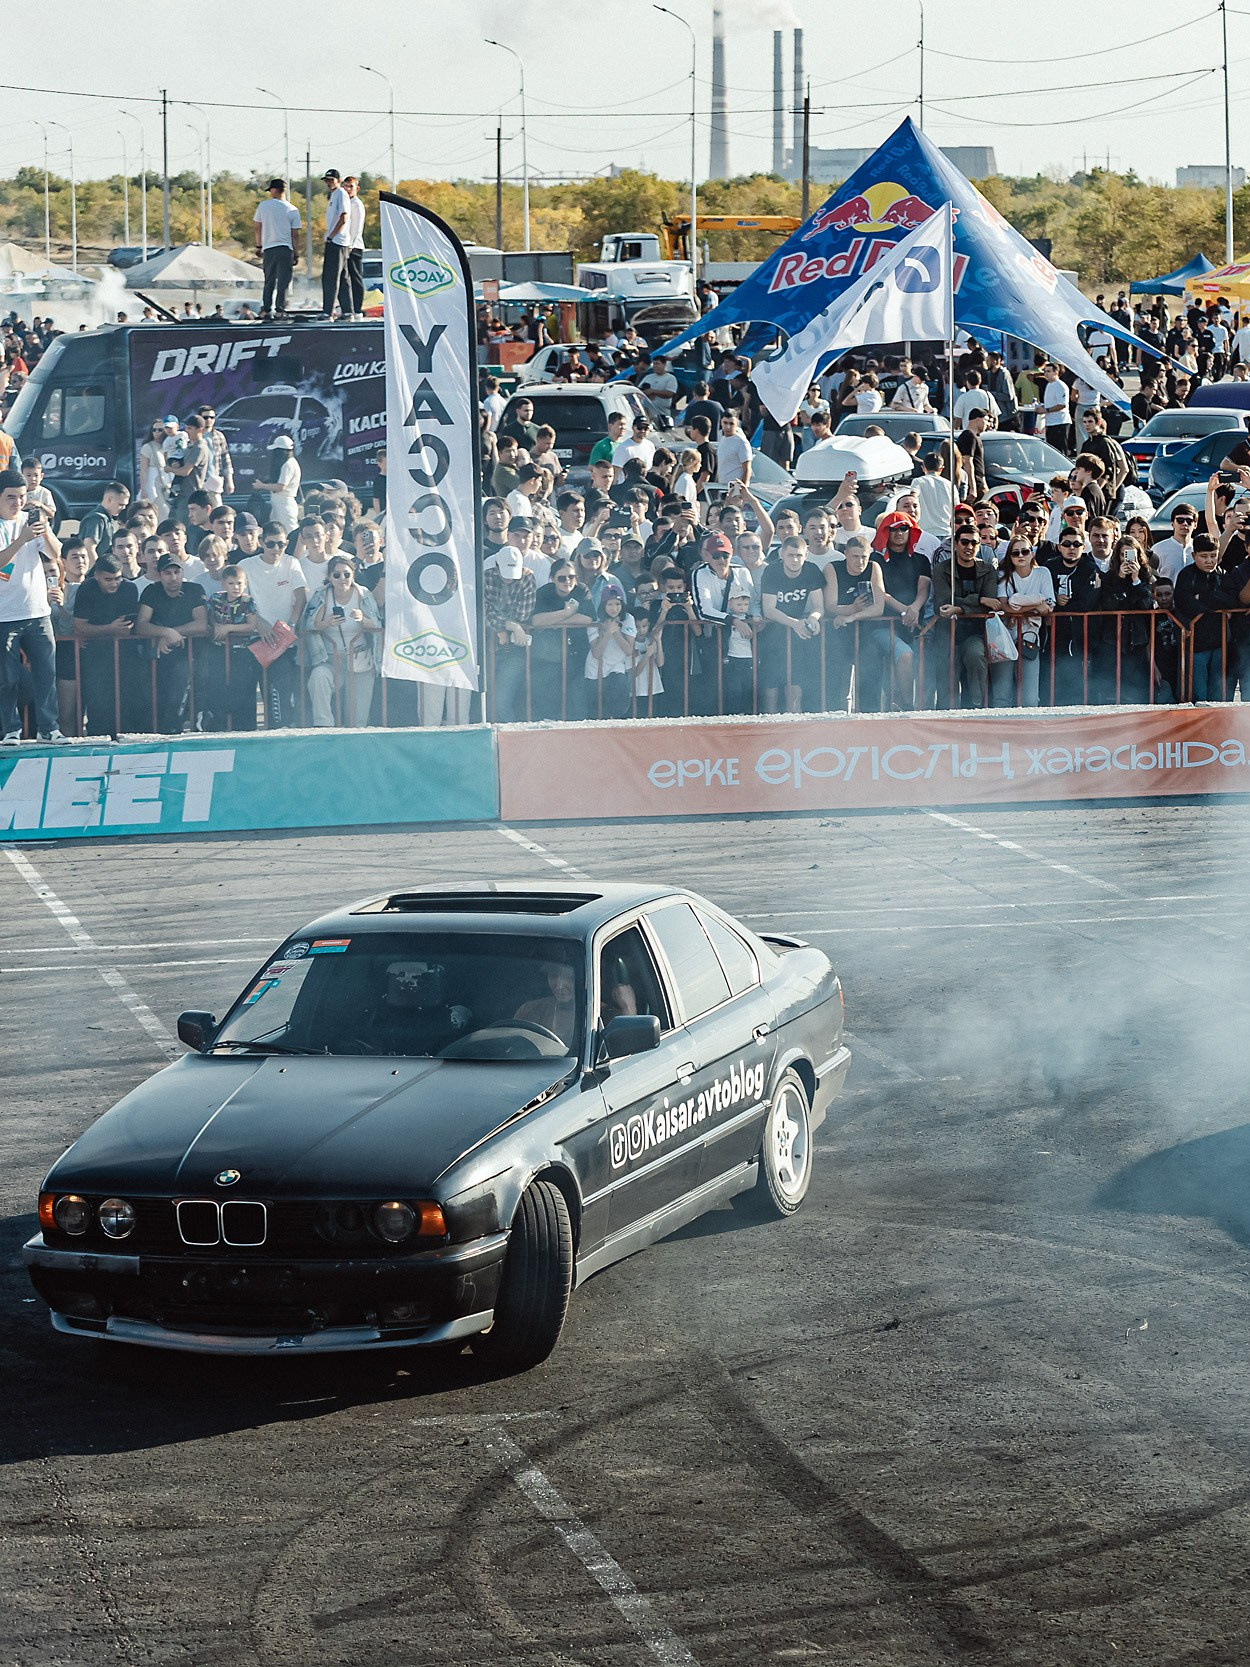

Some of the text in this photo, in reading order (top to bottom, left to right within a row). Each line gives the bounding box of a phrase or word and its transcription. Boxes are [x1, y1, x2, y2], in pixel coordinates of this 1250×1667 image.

[767, 237, 864, 294] Red
[150, 336, 292, 382] DRIFT
[333, 364, 369, 380] LOW
[58, 453, 107, 470] region
[777, 588, 807, 603] BOSS
[643, 1059, 764, 1151] Kaisar.avtoblog
